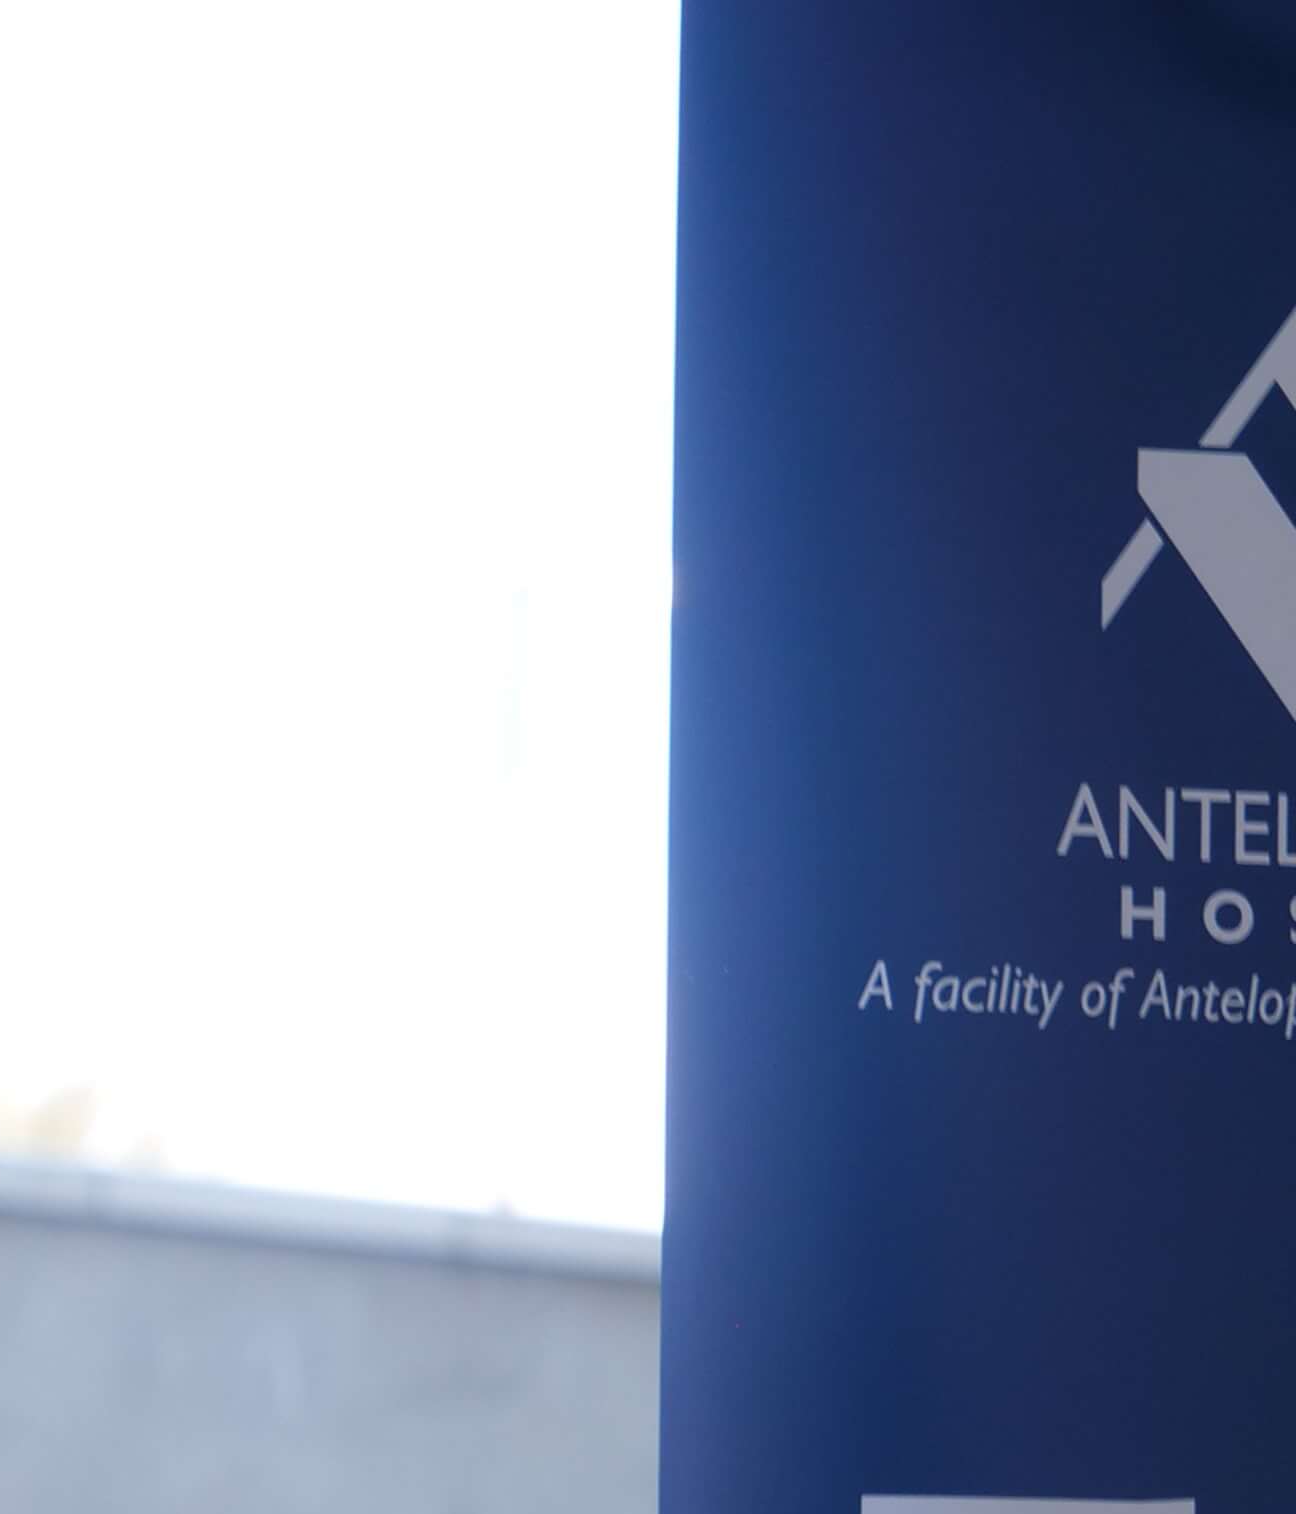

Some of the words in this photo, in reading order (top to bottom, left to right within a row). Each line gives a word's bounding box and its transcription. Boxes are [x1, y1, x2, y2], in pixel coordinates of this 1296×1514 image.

[1119, 884, 1296, 945] HO
[858, 958, 894, 1010] A
[913, 960, 1064, 1030] facility
[1080, 967, 1135, 1030] of
